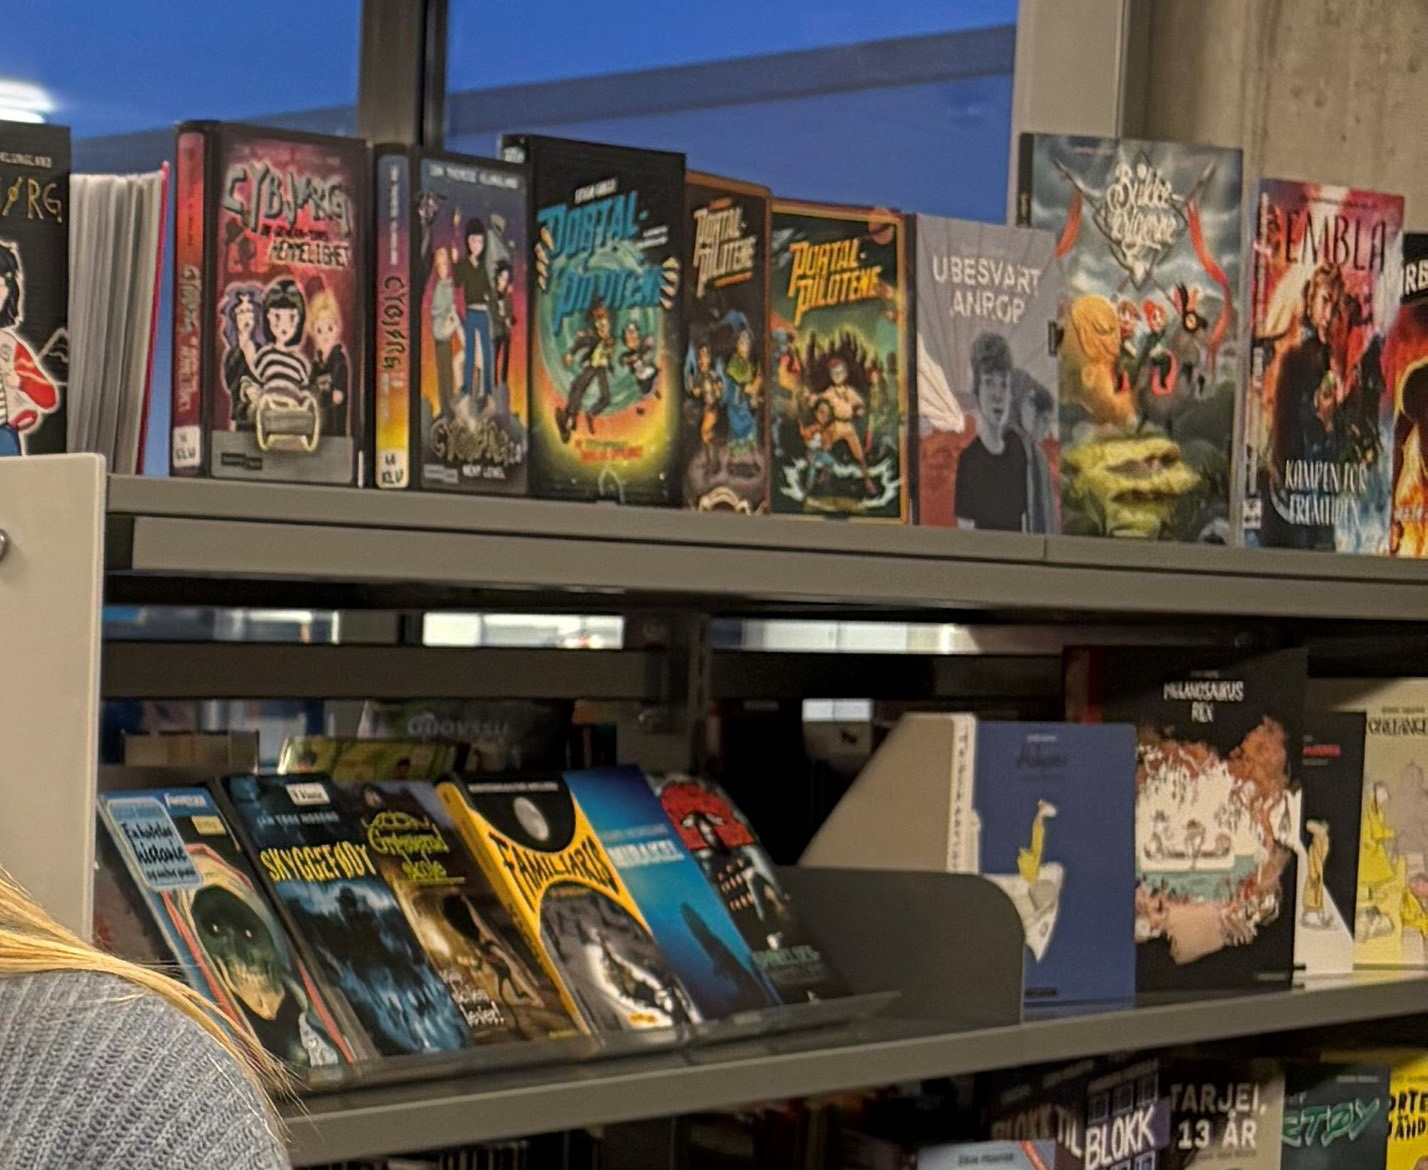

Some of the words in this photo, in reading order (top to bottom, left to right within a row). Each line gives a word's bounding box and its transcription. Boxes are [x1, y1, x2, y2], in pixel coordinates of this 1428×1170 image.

[932, 255, 1041, 297] UBESVART
[950, 290, 1026, 325] ANROP
[1177, 1118, 1210, 1150] 13
[1221, 1108, 1257, 1150] ÅR
